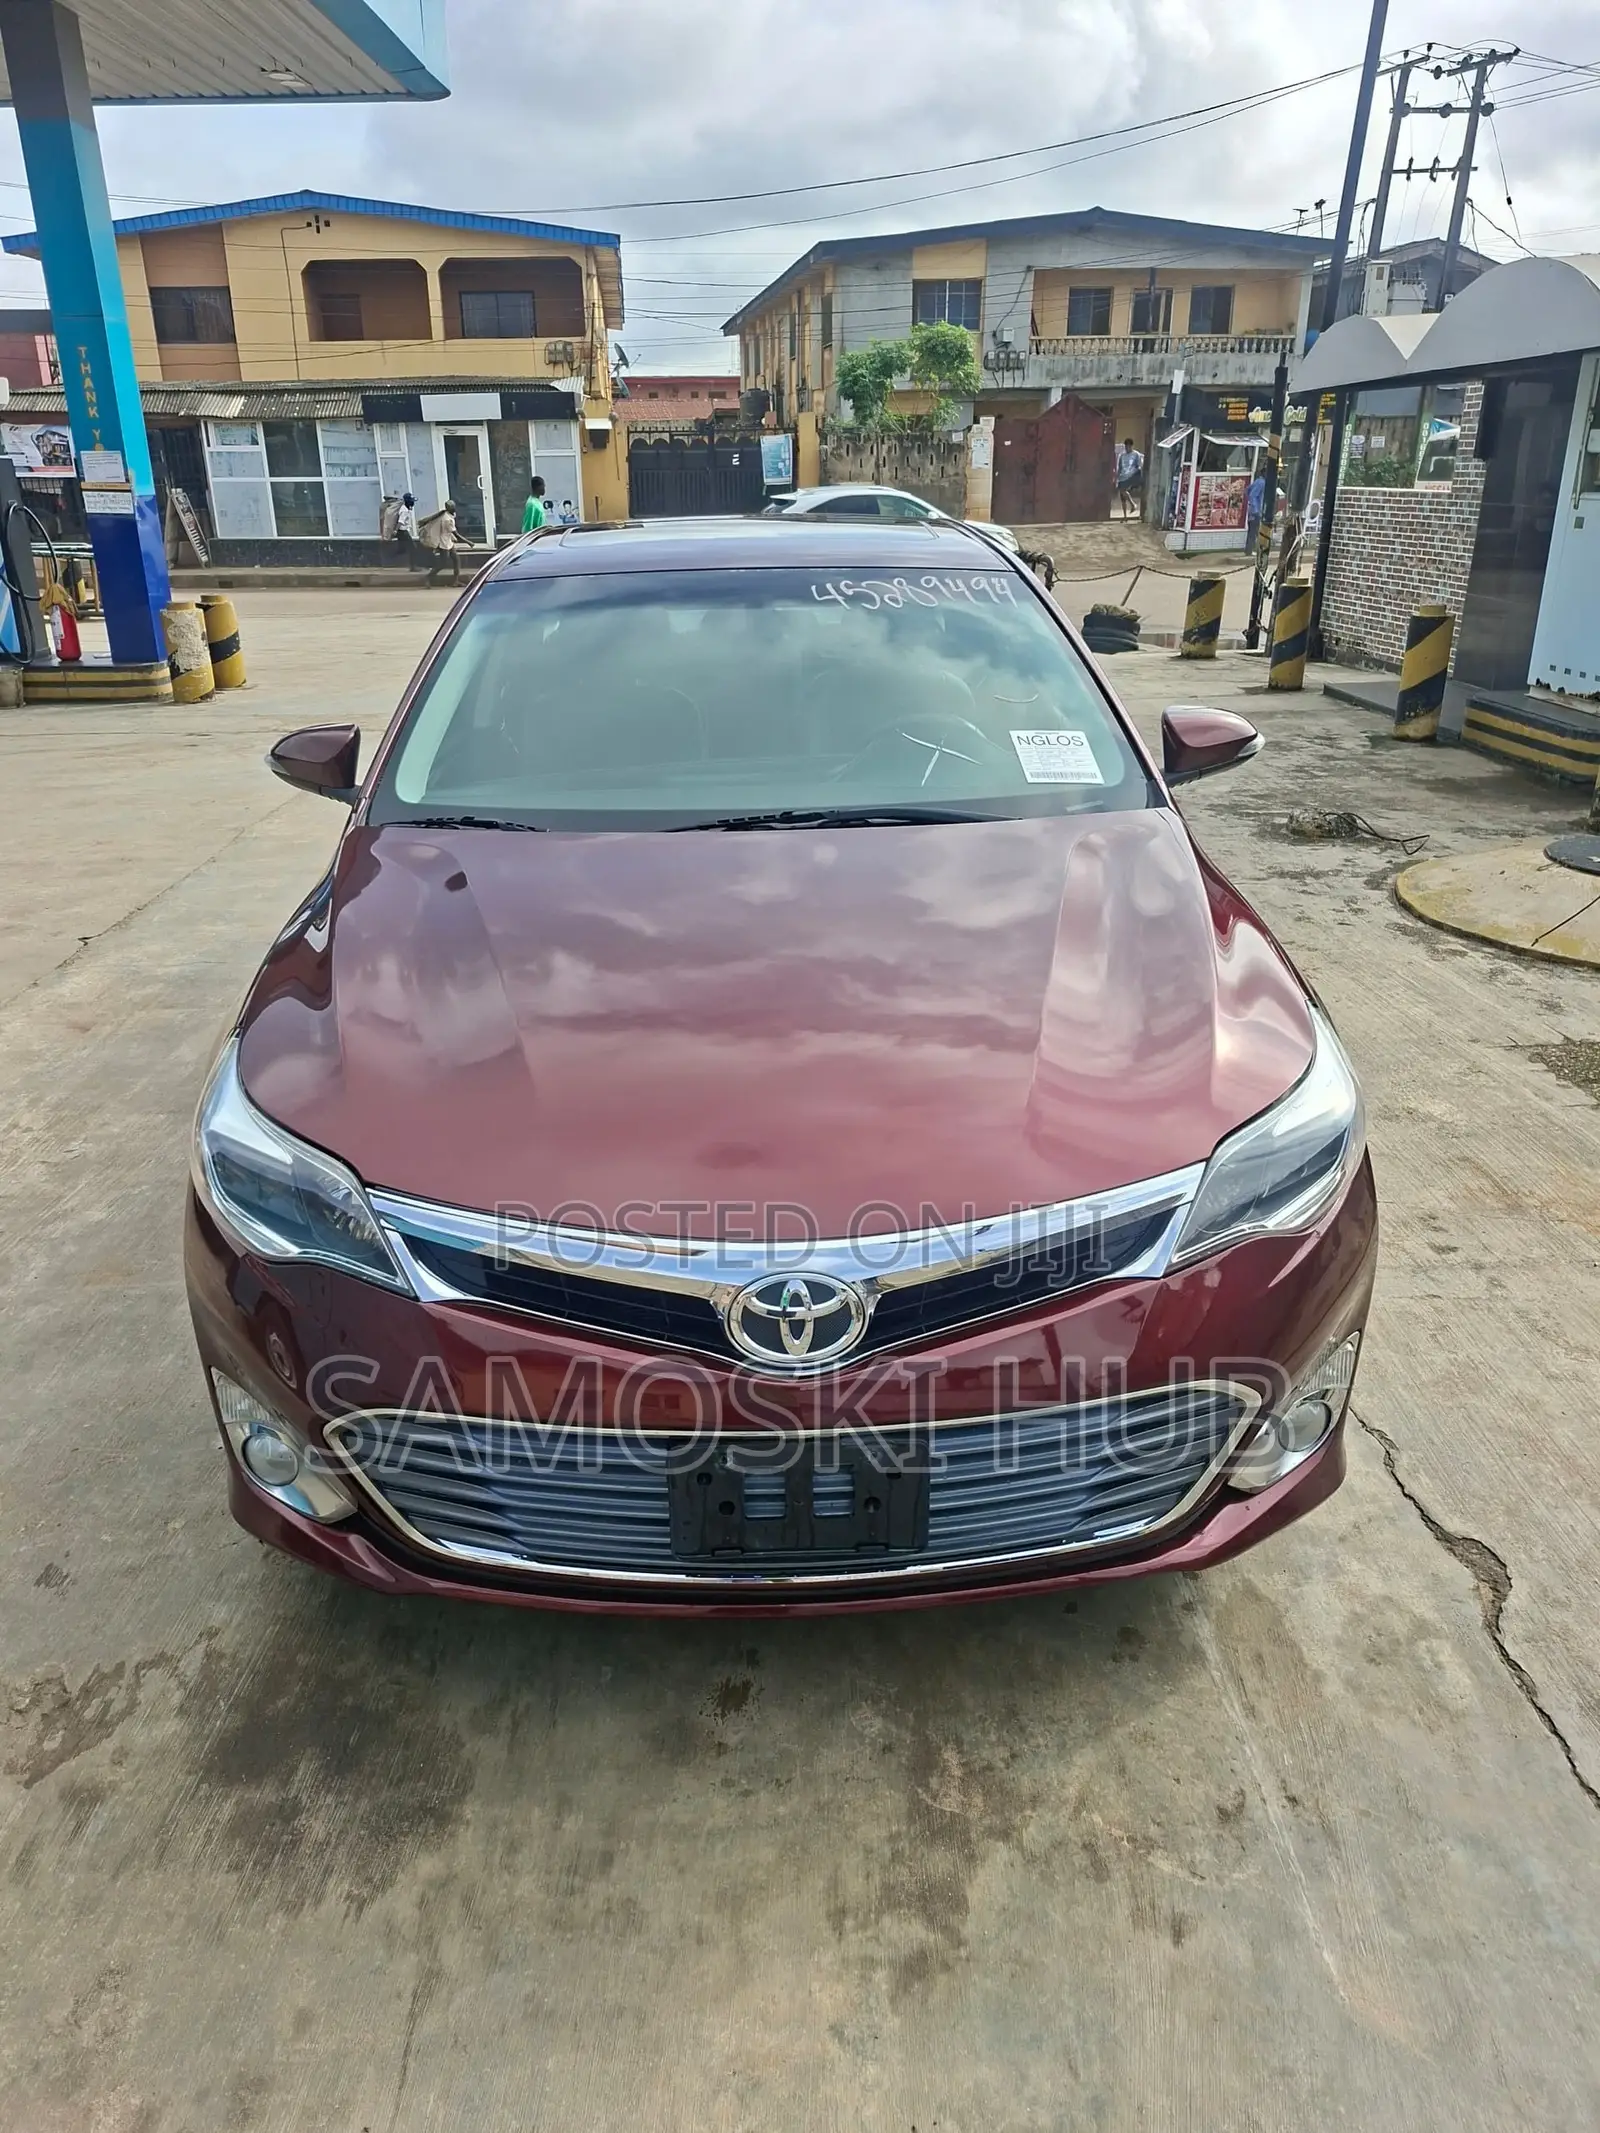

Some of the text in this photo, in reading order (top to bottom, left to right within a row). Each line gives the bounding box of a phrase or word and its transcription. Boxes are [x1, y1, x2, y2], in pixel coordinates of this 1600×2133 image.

[77, 346, 100, 418] THANK
[92, 428, 105, 452] YO
[1283, 405, 1308, 426] Gold
[1016, 734, 1084, 747] NGLOS
